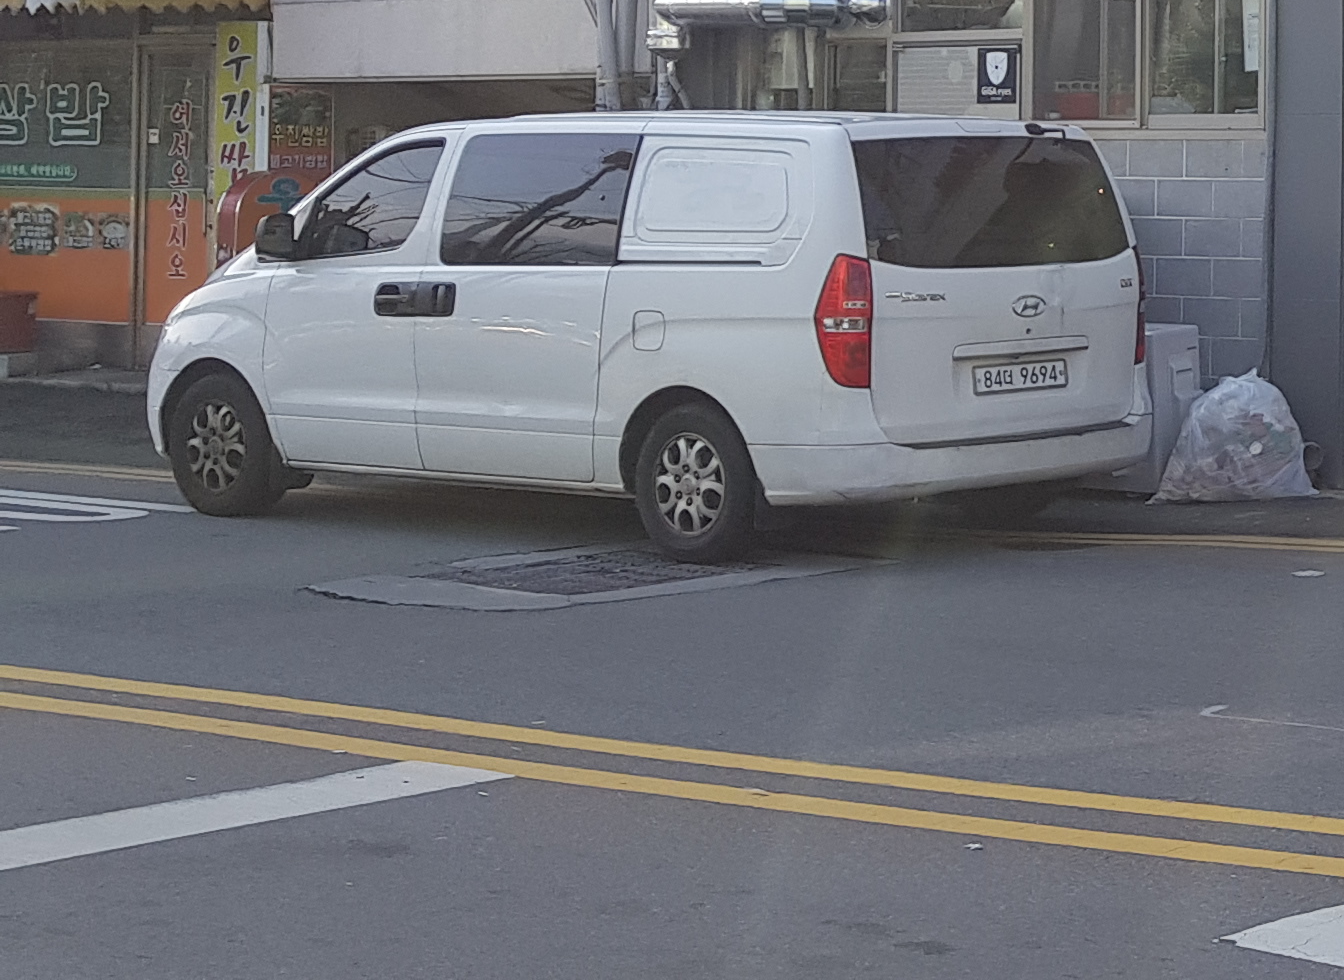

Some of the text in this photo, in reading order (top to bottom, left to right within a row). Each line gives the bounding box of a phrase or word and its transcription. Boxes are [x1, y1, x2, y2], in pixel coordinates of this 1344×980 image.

[168, 99, 192, 279] 어서오십시오
[984, 364, 1059, 389] 84더 9694
